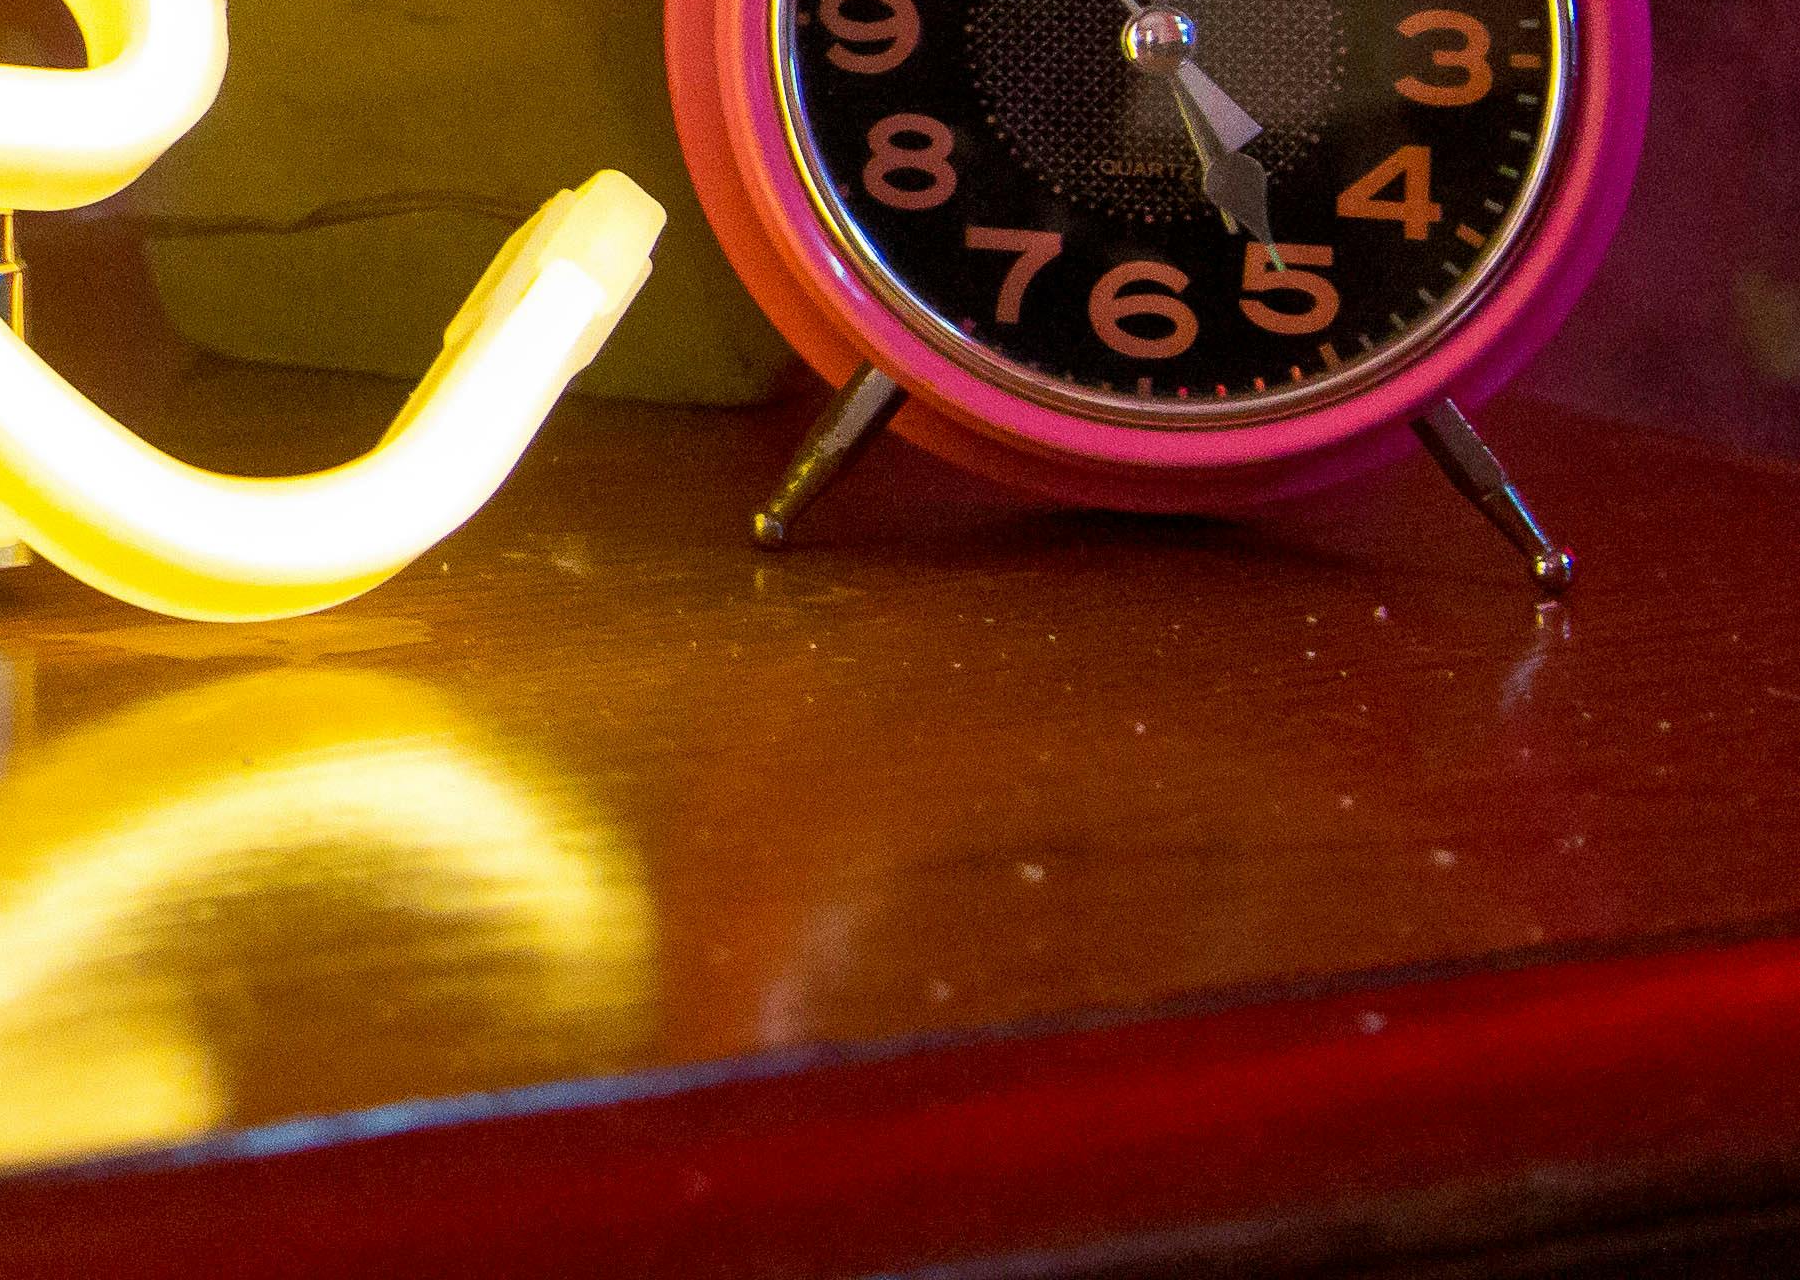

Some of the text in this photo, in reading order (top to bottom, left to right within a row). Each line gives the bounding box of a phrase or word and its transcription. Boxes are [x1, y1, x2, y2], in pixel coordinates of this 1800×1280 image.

[1397, 10, 1493, 107] 3
[862, 113, 957, 210] 8
[1336, 145, 1442, 241] 4
[965, 226, 1063, 324] 7
[1088, 261, 1200, 359] 6
[1238, 242, 1341, 336] 5
